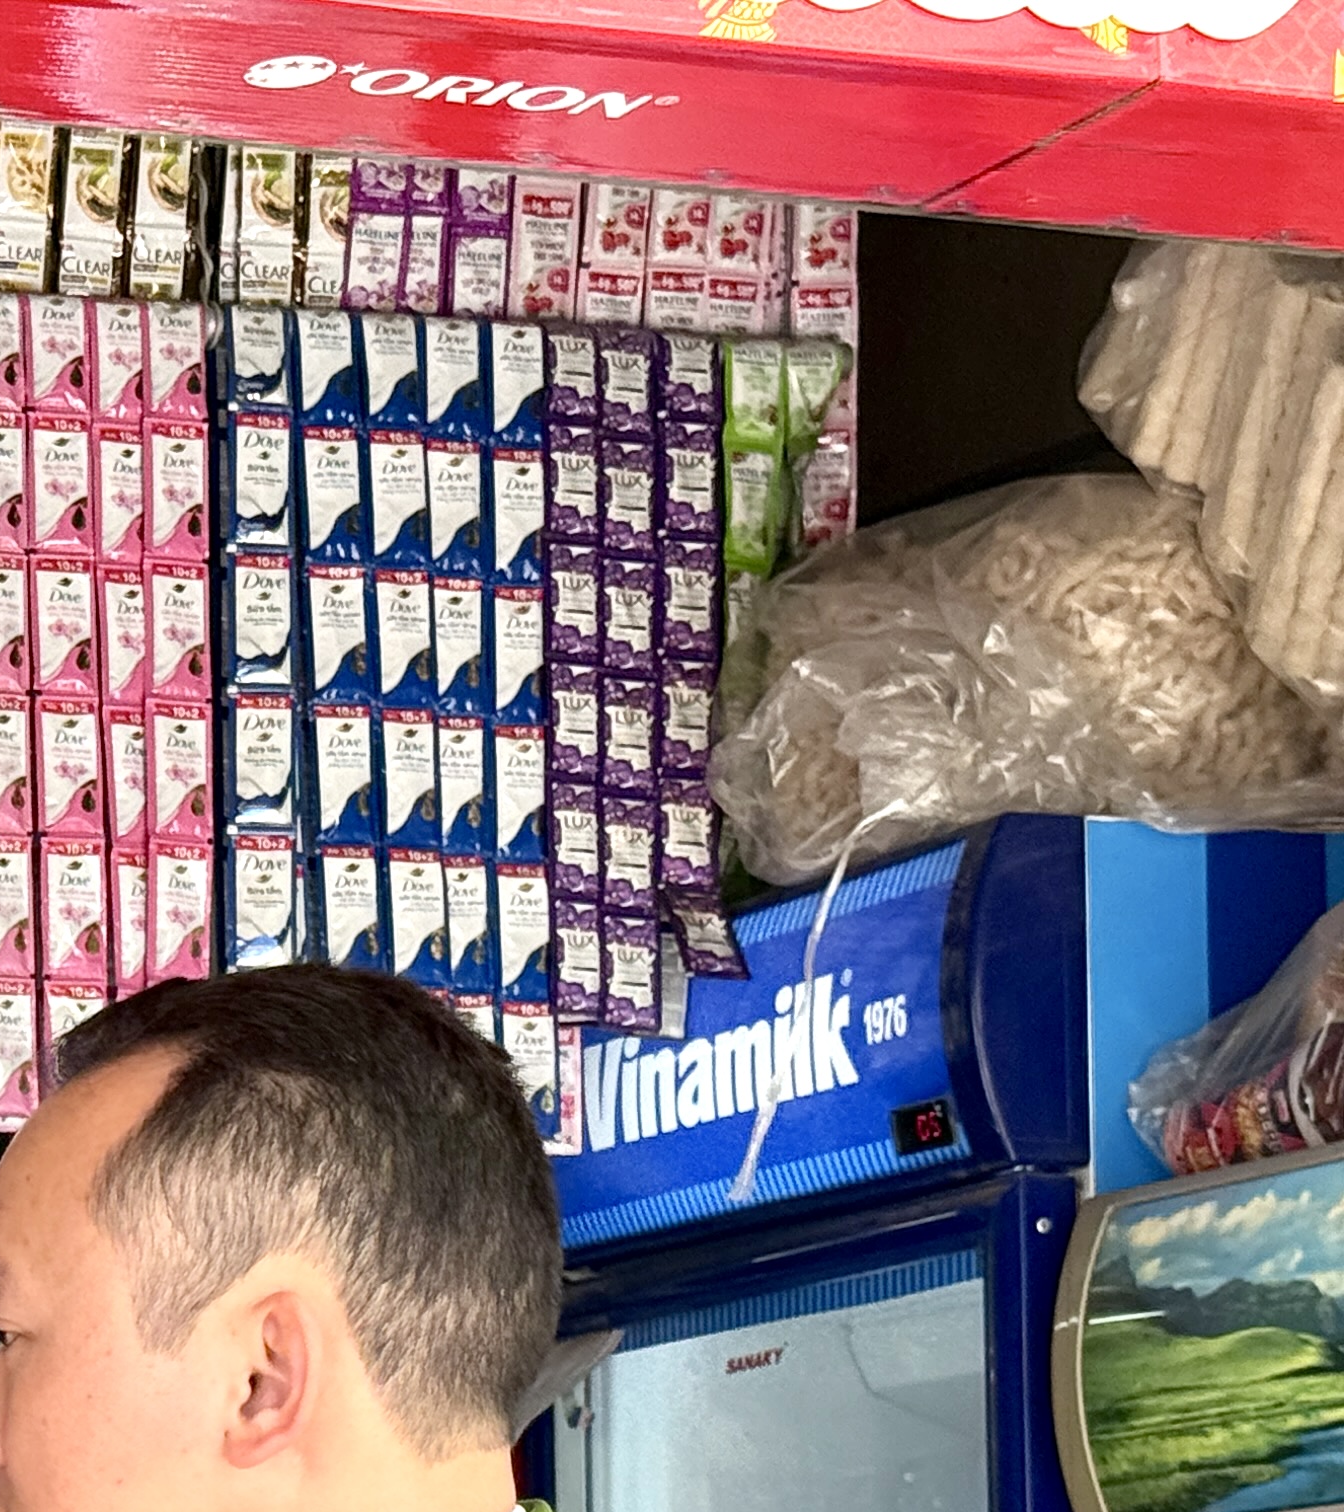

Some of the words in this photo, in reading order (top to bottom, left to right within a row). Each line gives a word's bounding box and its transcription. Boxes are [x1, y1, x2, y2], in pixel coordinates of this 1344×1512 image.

[349, 66, 653, 119] ORION
[62, 258, 111, 276] CLEAR
[241, 261, 290, 279] CLEAR
[610, 354, 641, 370] LUX
[243, 433, 285, 451] Dove
[563, 575, 593, 589] LUX
[164, 594, 196, 610] Dove
[564, 695, 593, 709] LUX
[243, 714, 287, 731] Dove
[329, 736, 362, 748] Dove
[243, 854, 287, 871] Dove
[583, 973, 859, 1152] Vinamilk
[863, 995, 907, 1046] 1976
[726, 1347, 784, 1375] SANAKY
